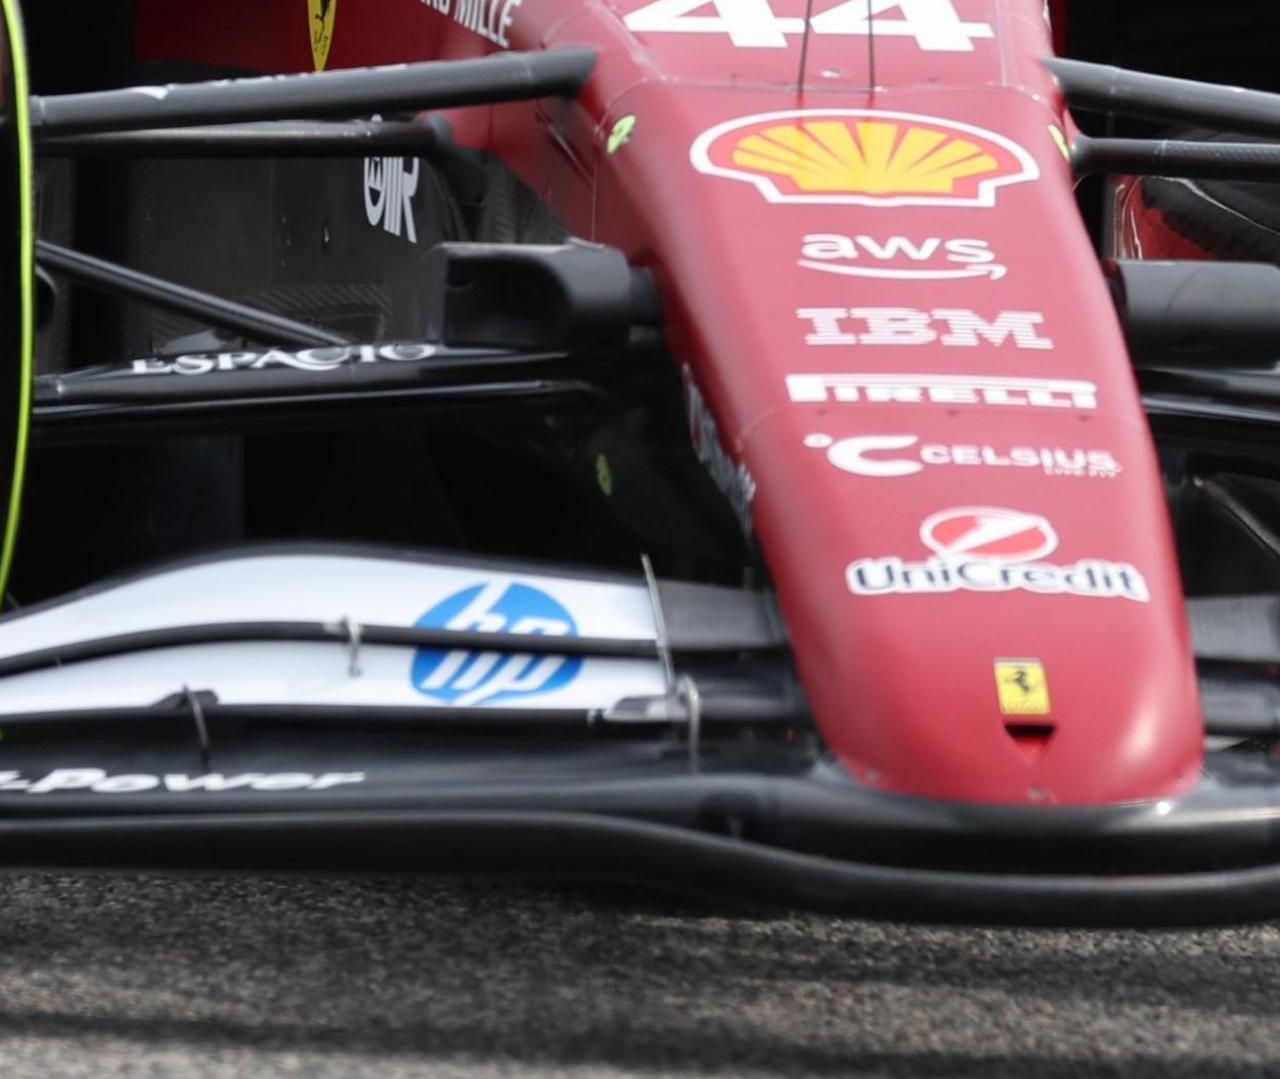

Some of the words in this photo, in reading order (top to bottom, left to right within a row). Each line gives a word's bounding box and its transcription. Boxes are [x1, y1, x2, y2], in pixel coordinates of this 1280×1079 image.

[799, 233, 1000, 269] aws
[795, 307, 1054, 350] IBM
[786, 374, 1098, 409] PIRELLI
[920, 443, 1120, 471] CELSIUS
[854, 560, 1144, 594] UniCredit
[418, 580, 575, 704] hp
